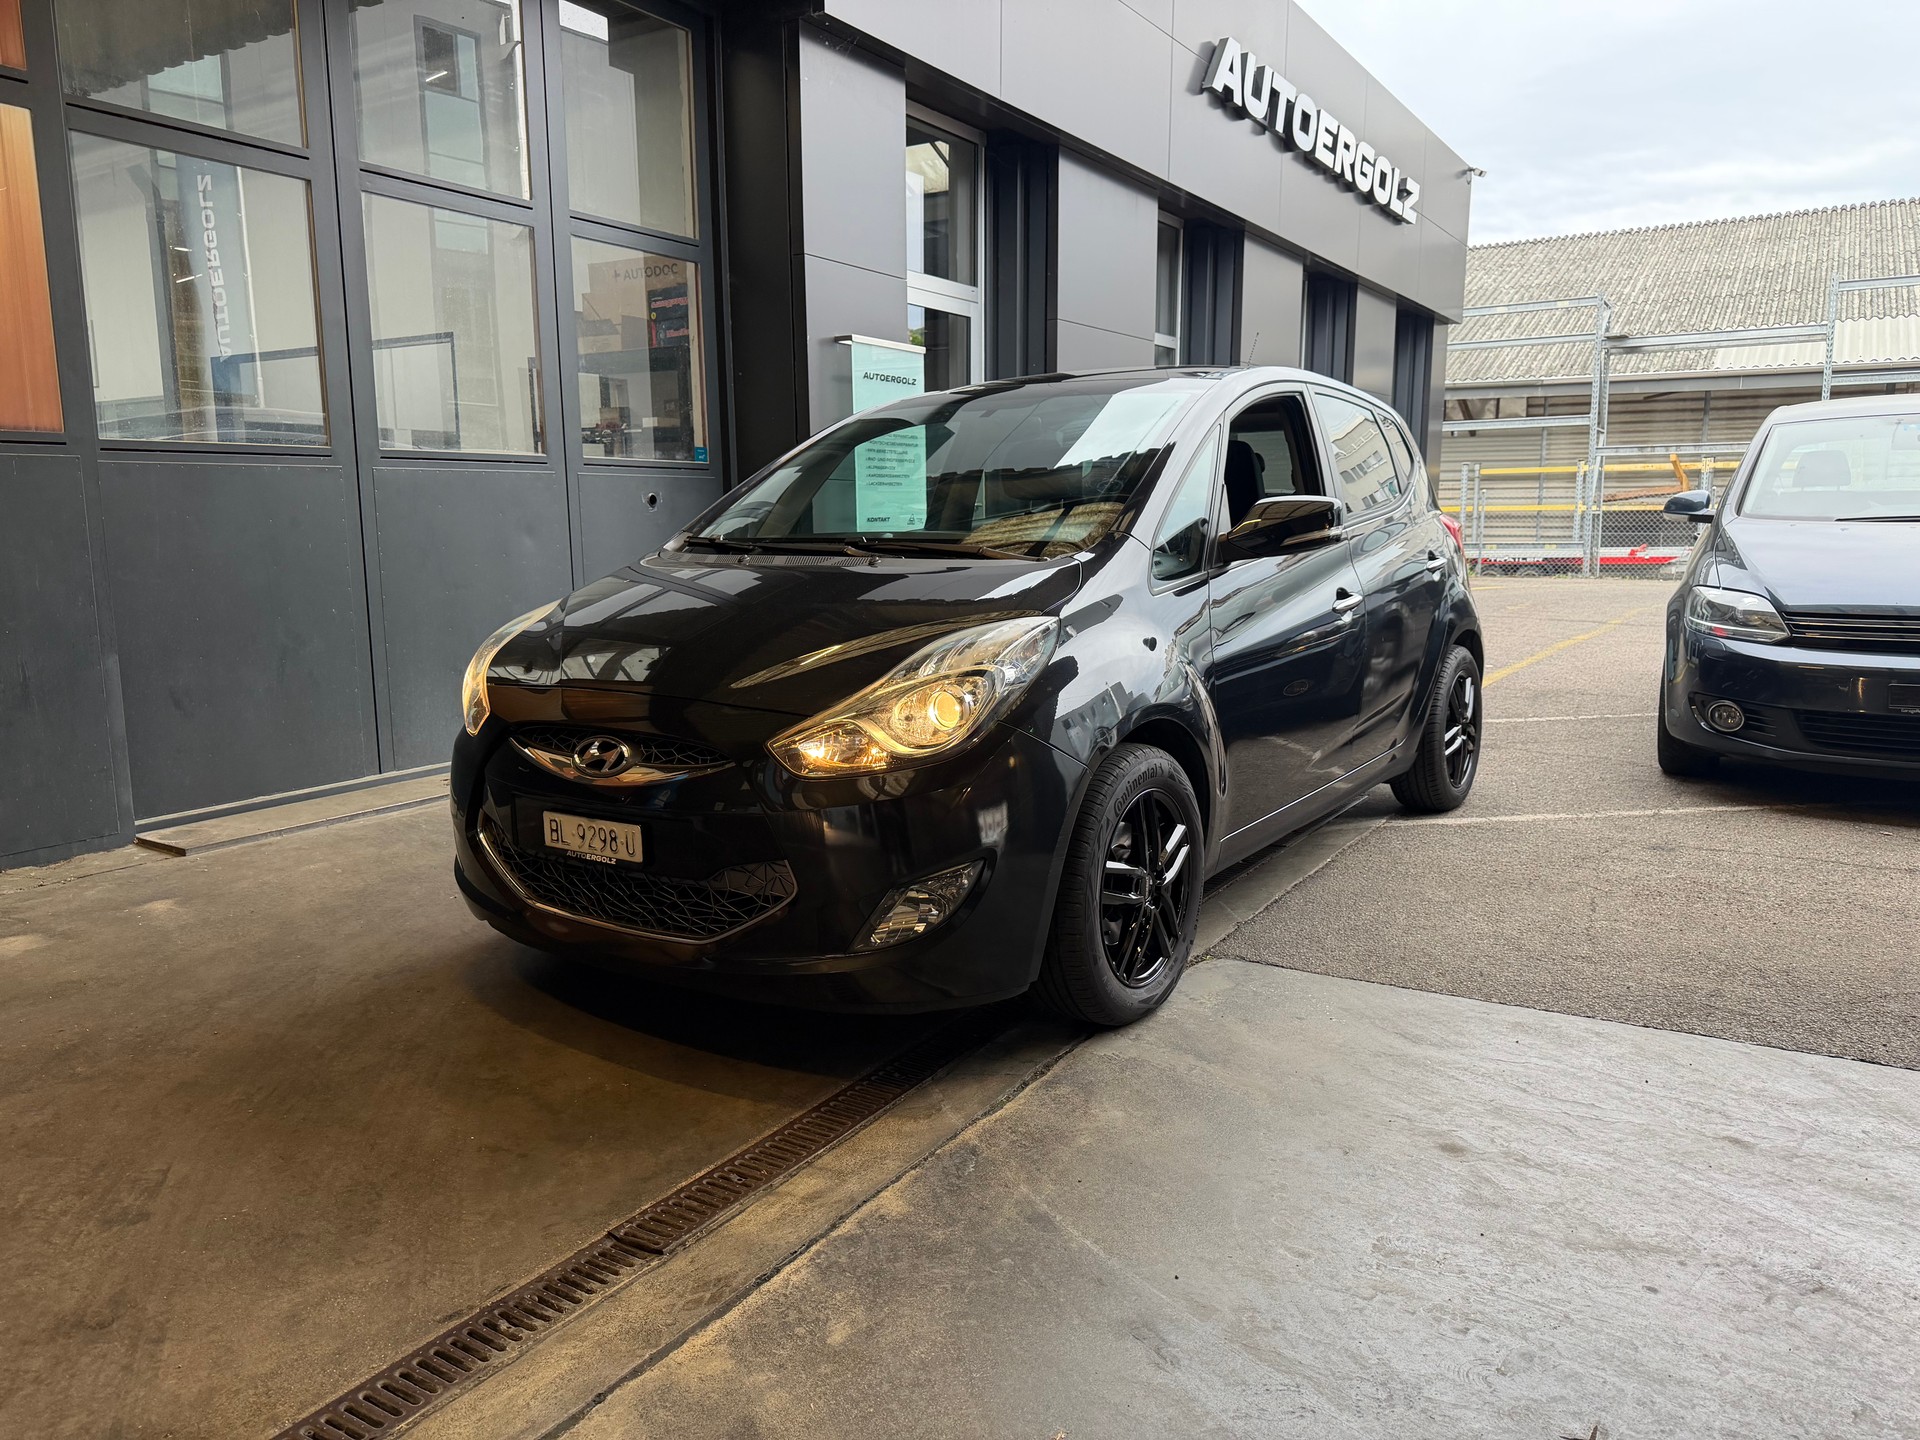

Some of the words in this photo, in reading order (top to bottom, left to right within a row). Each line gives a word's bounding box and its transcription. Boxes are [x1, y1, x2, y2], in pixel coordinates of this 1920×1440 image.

[1204, 37, 1421, 225] AUTOERGOLZ
[624, 263, 678, 281] AUTODOC
[863, 371, 917, 386] AUTOERGOLZ
[1114, 763, 1157, 817] Continental
[566, 850, 617, 865] AUTOERGOLZ
